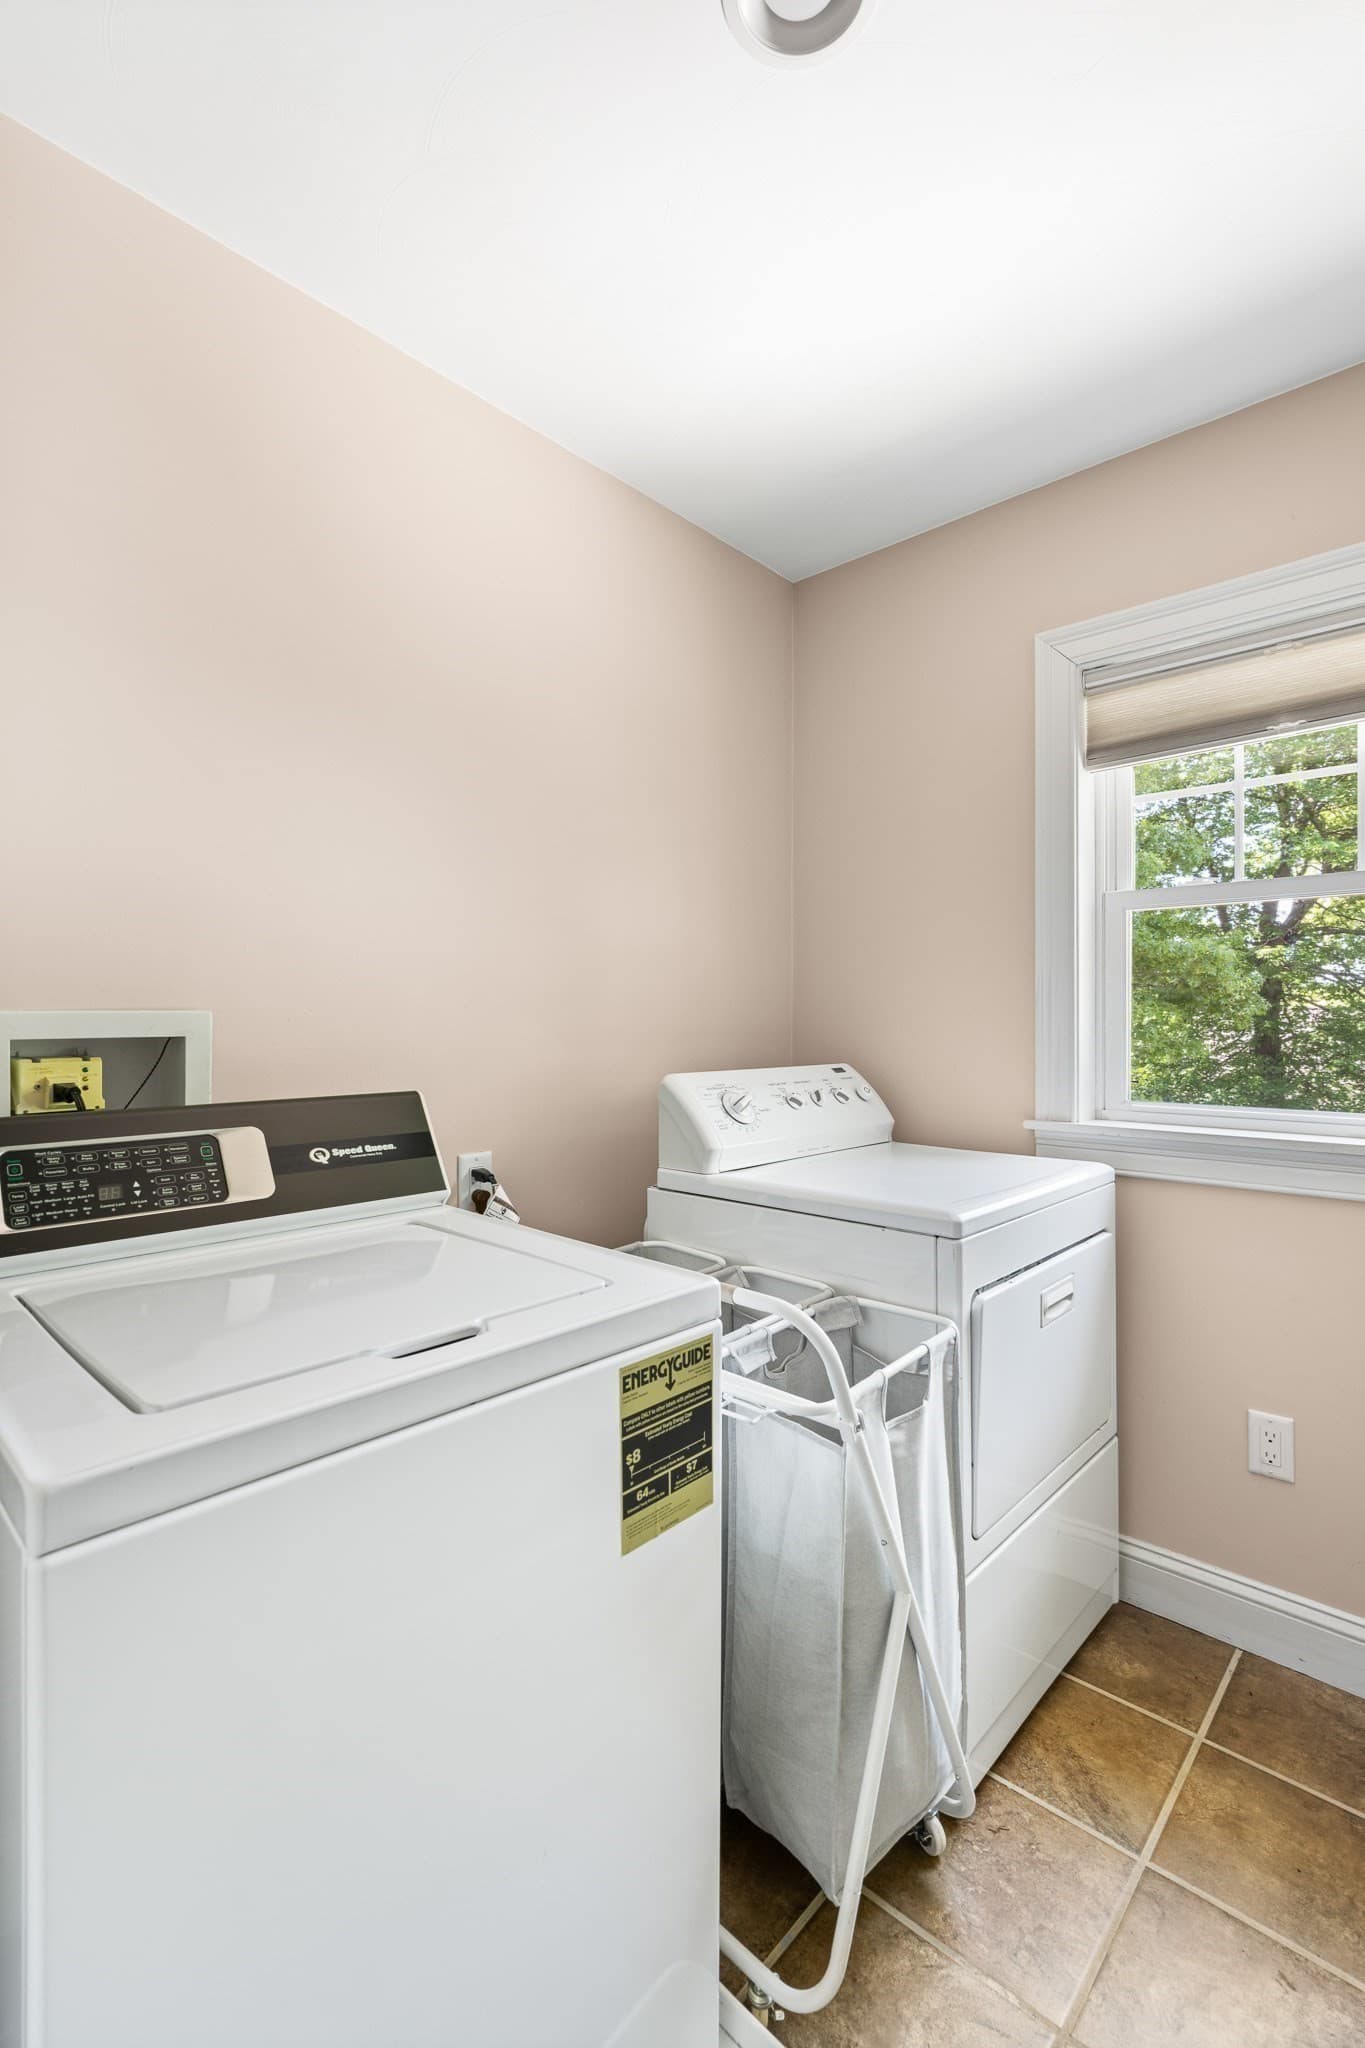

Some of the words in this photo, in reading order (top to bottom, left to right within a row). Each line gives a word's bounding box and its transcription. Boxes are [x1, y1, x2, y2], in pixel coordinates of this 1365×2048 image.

[331, 1146, 363, 1157] Speed
[622, 1343, 712, 1394] ENERGYGUIDE
[625, 1448, 641, 1466] $8
[686, 1459, 698, 1474] $7
[636, 1486, 649, 1501] 64
